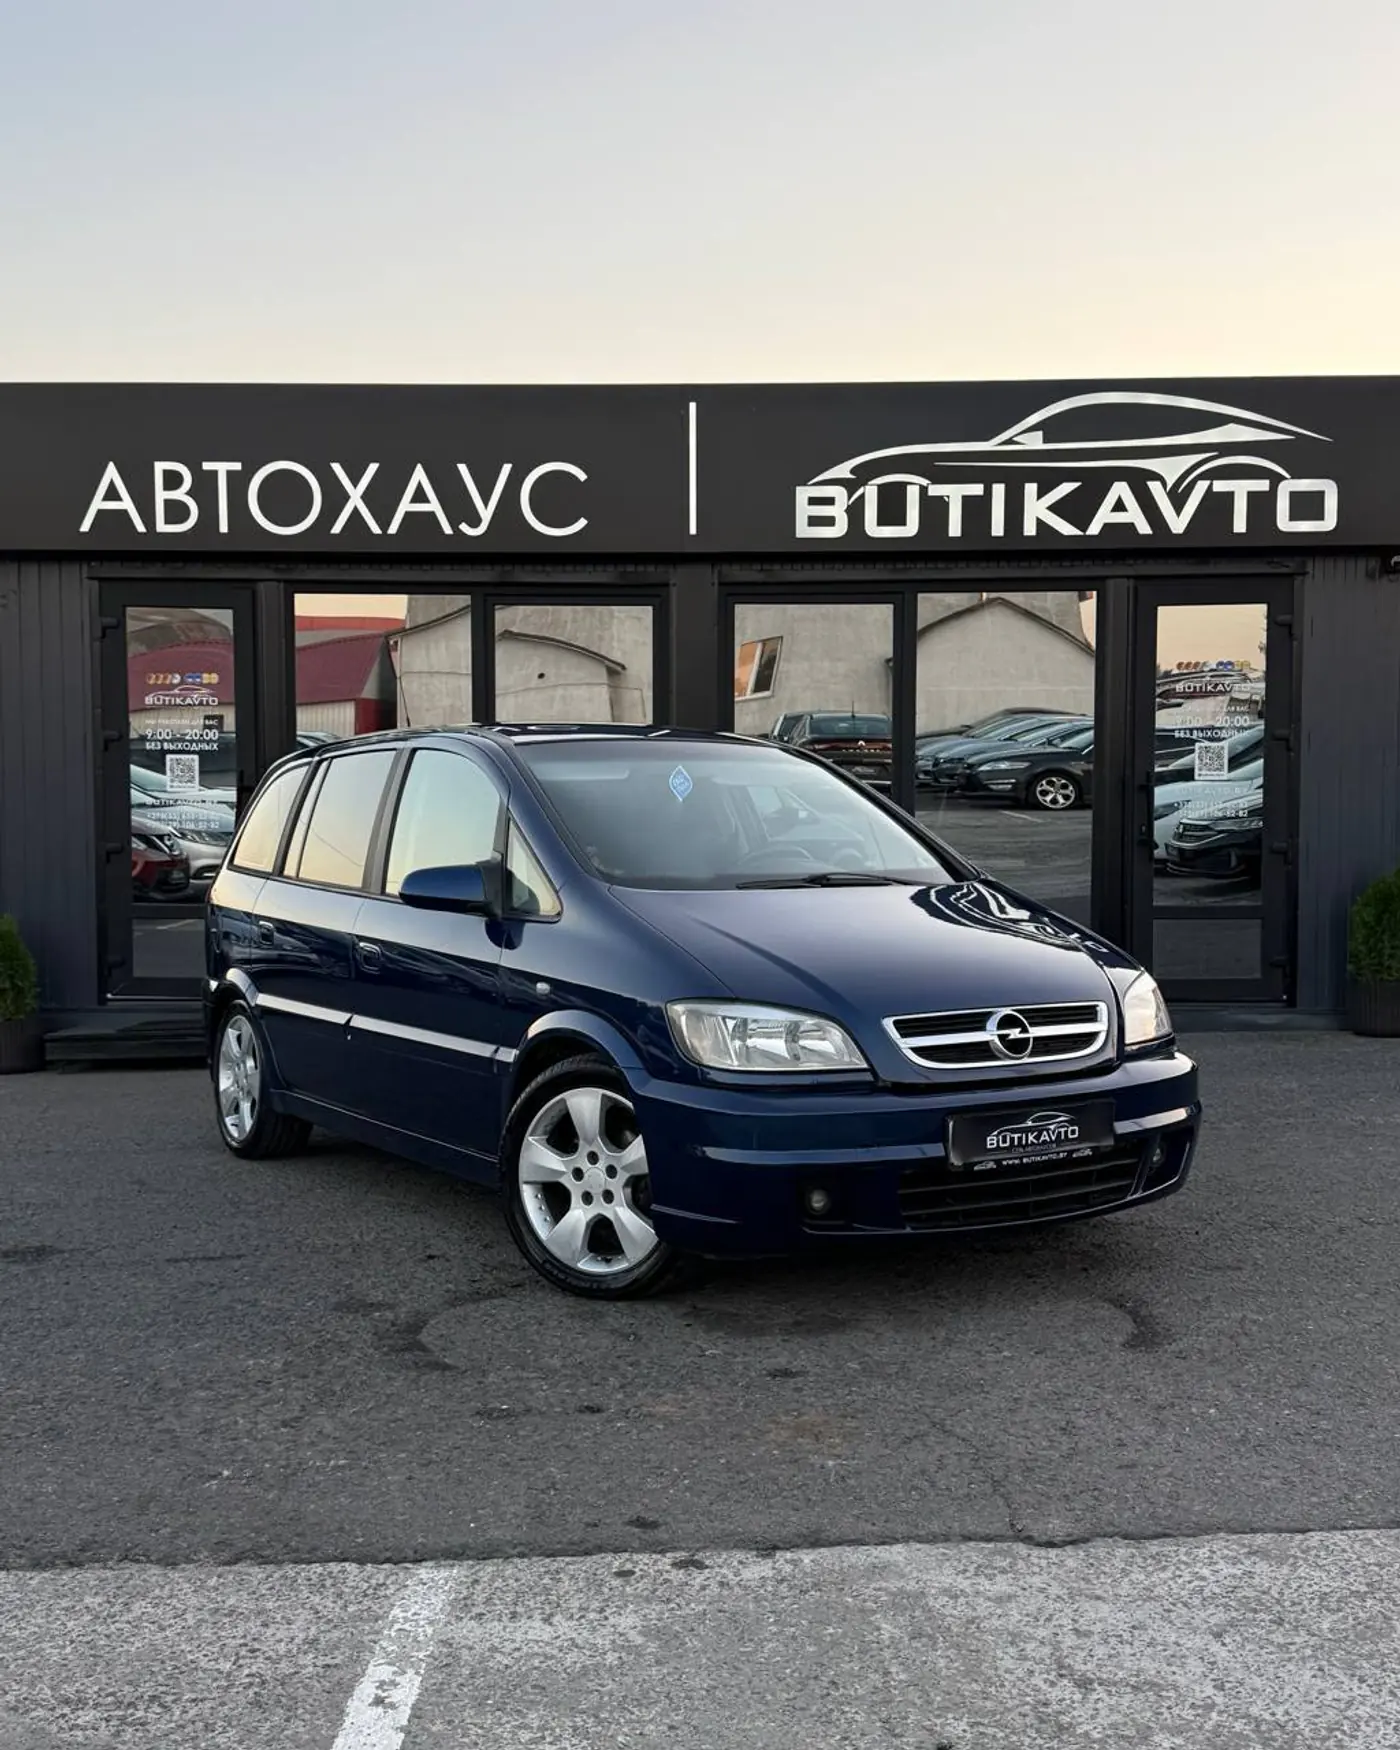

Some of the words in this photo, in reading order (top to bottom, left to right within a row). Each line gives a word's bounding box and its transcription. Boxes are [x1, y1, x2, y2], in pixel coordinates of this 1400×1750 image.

[79, 460, 588, 537] АВТОХАУС
[796, 478, 1337, 538] BUTIKAVTO
[1176, 683, 1250, 692] BUTIKAVTO
[145, 696, 218, 705] BUTIKAVTO
[1216, 716, 1249, 727] 20:00
[146, 729, 172, 740] 9:00
[184, 729, 219, 740] 20:00
[146, 742, 161, 750] БЕЗ
[163, 742, 218, 751] ВЫХОДНЫХ
[986, 1126, 1079, 1149] BUTIKAVTO
